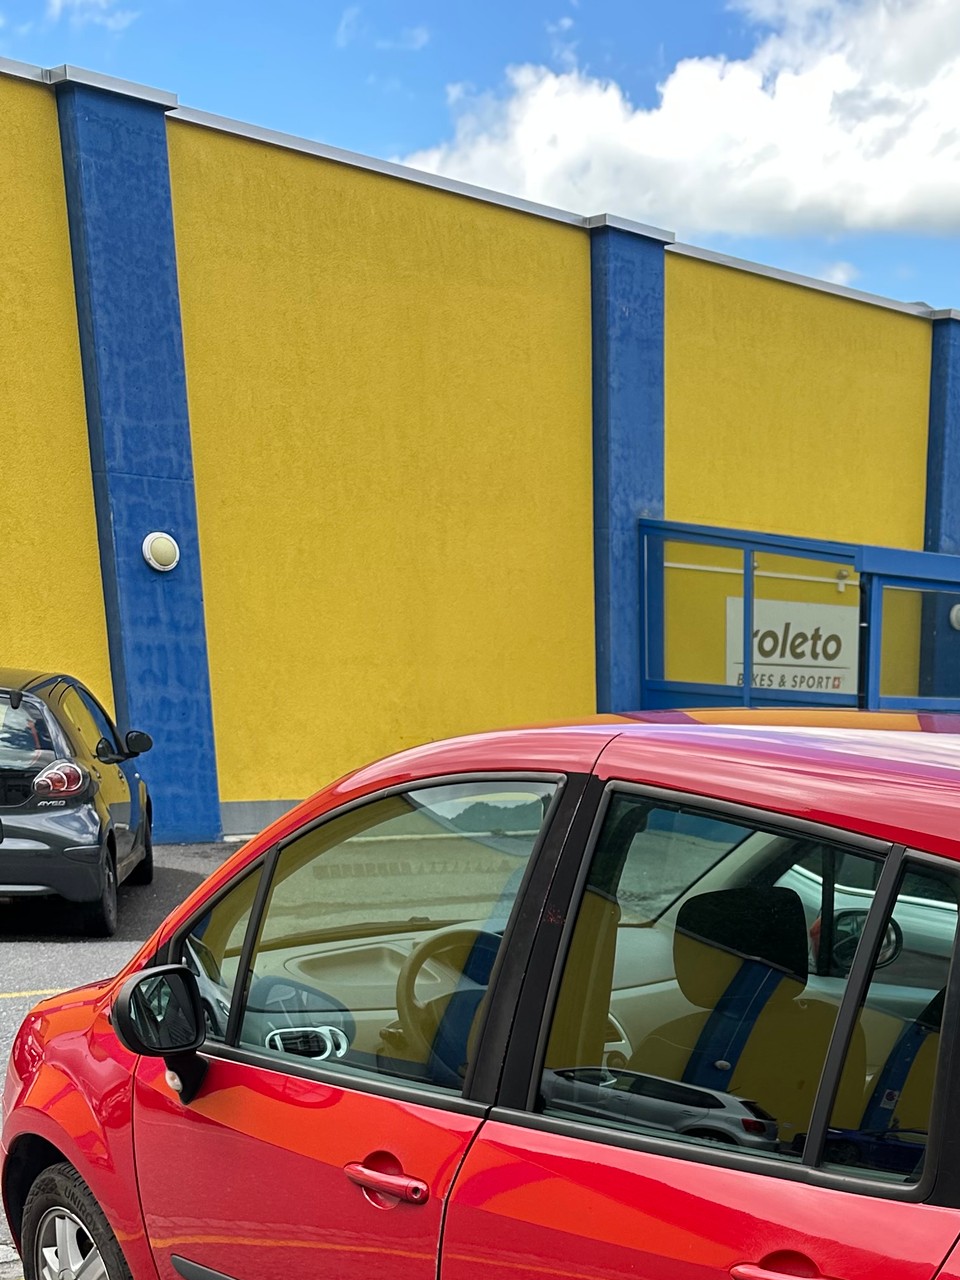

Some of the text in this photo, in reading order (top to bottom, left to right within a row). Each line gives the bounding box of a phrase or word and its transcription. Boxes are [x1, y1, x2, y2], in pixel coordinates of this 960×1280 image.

[737, 673, 831, 689] BKES & SPORT
